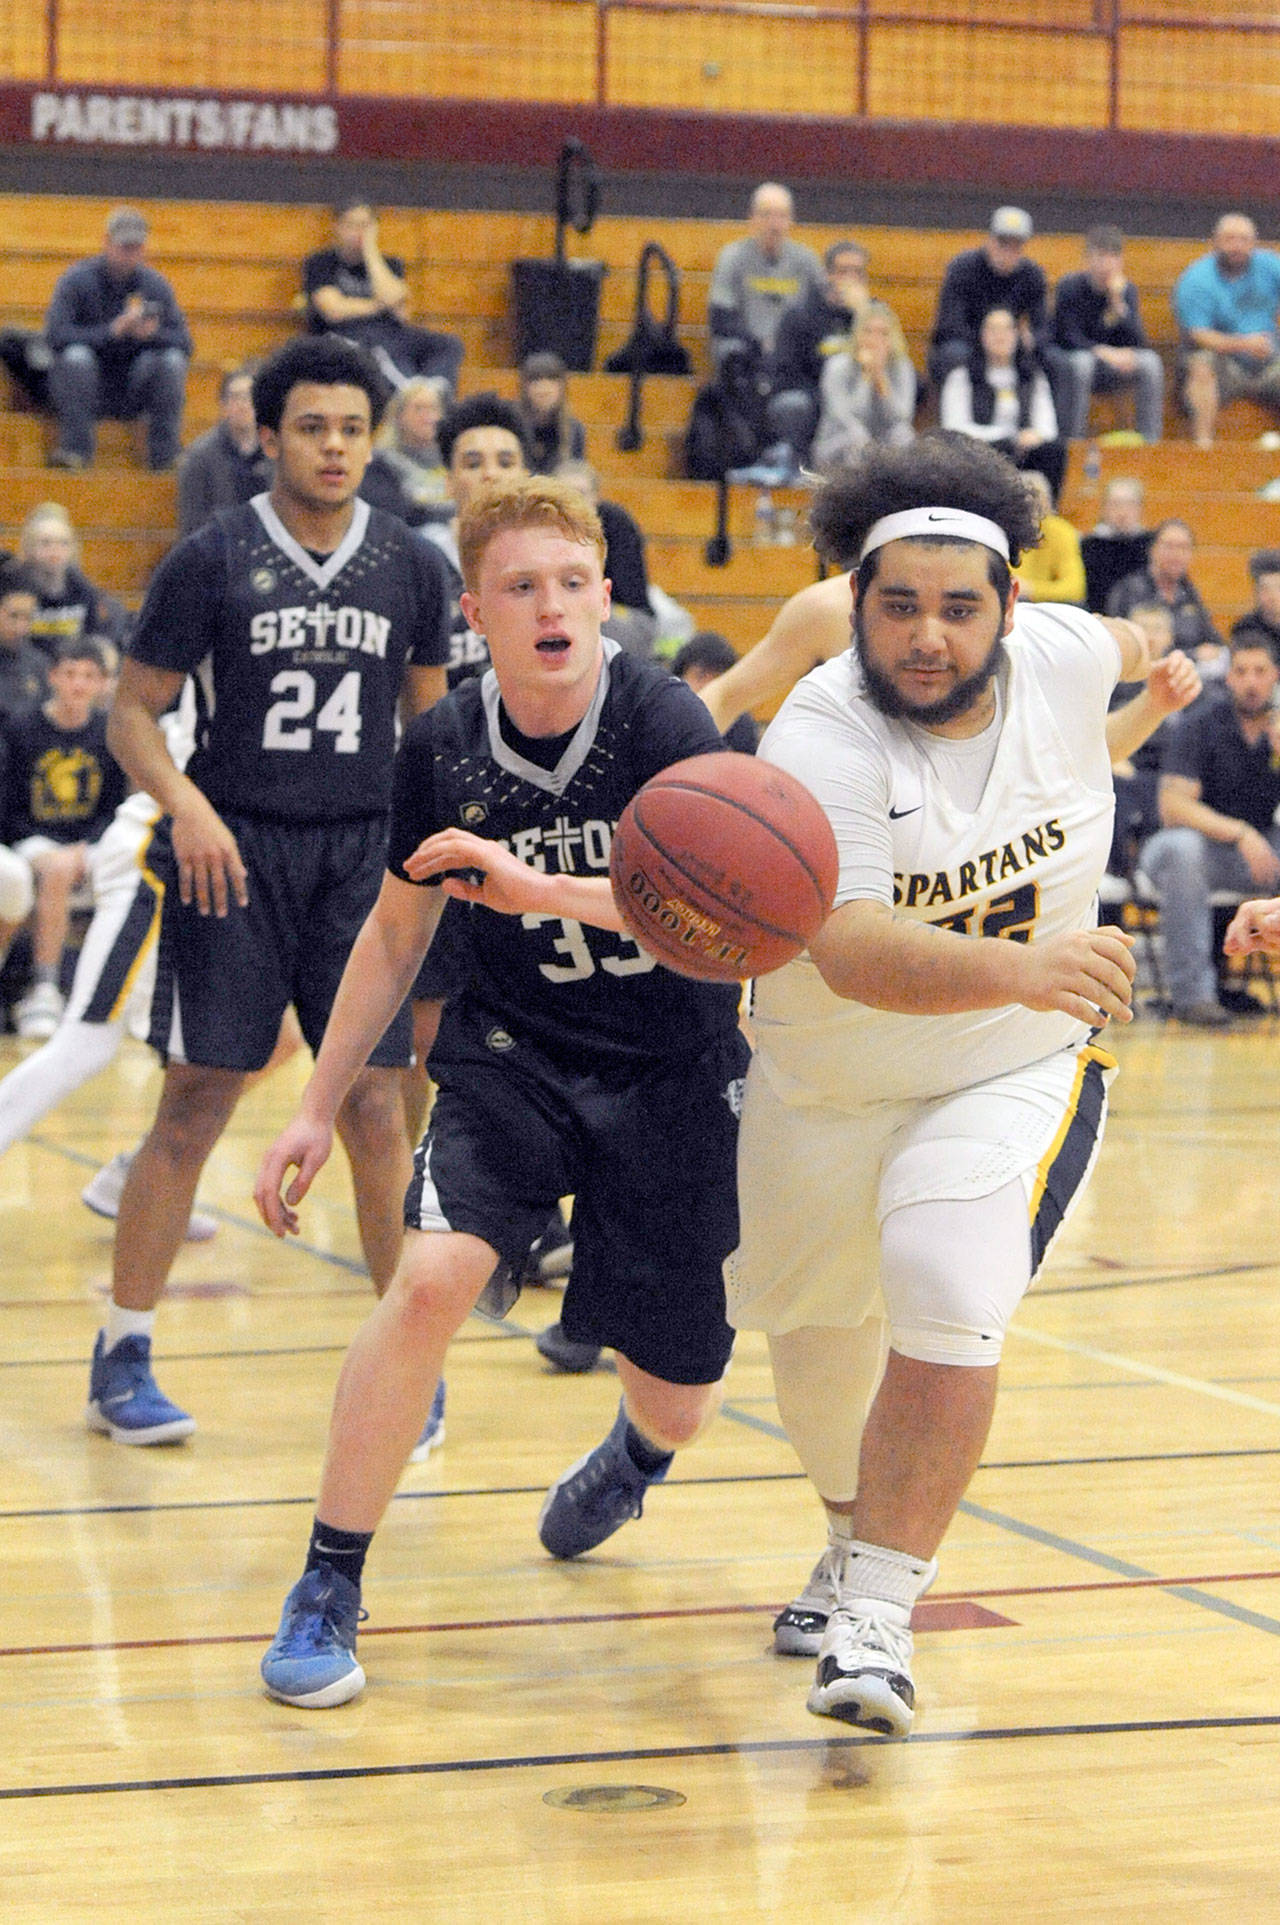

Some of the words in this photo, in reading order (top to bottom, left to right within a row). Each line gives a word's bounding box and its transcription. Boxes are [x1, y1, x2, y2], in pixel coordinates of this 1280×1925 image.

[250, 602, 392, 660] SETON
[262, 669, 362, 754] 24
[499, 815, 618, 873] ETO
[893, 817, 1067, 908] SPARTANS
